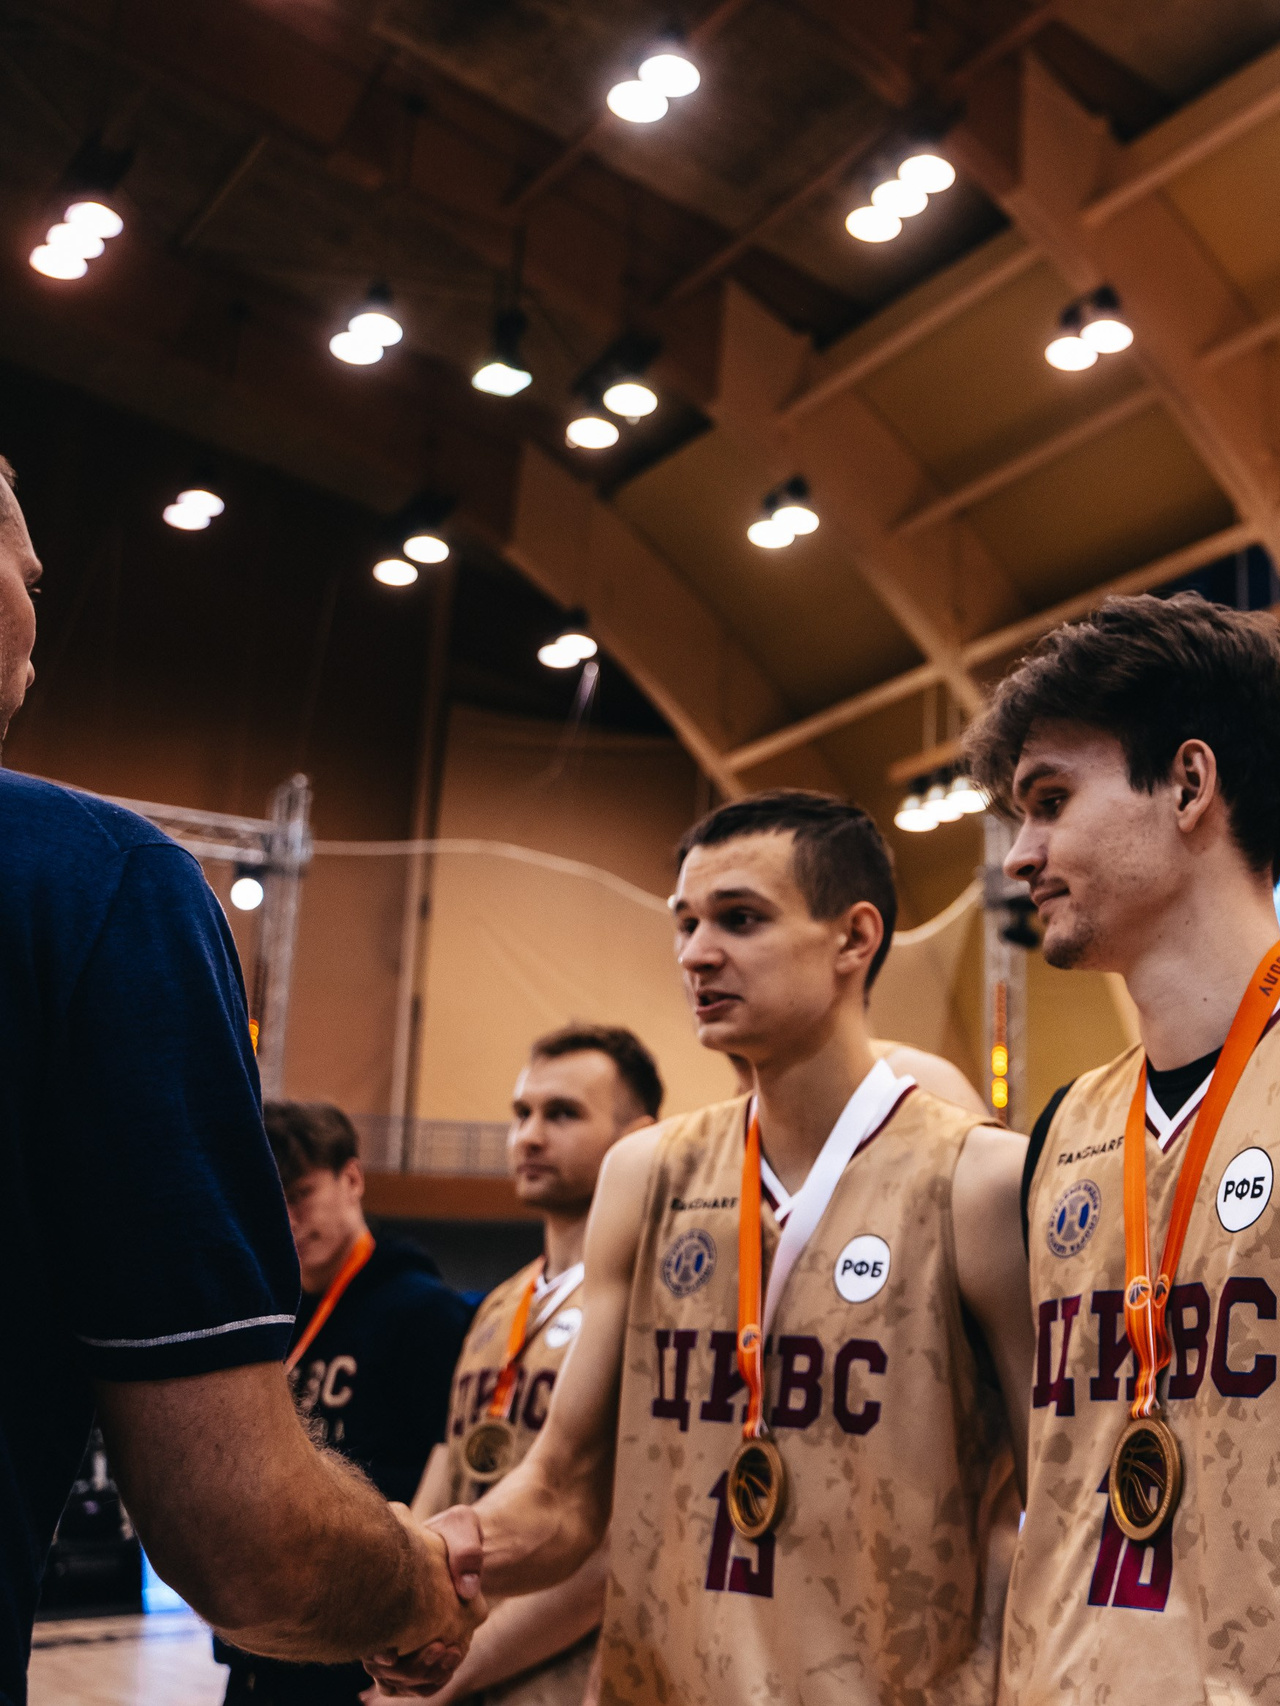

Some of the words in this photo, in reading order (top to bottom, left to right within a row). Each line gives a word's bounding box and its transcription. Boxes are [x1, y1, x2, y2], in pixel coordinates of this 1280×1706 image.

[1223, 1176, 1265, 1203] РФБ
[841, 1259, 884, 1278] РФБ
[1033, 1276, 1277, 1417] ЦИВС
[652, 1329, 888, 1436] ЦИВС
